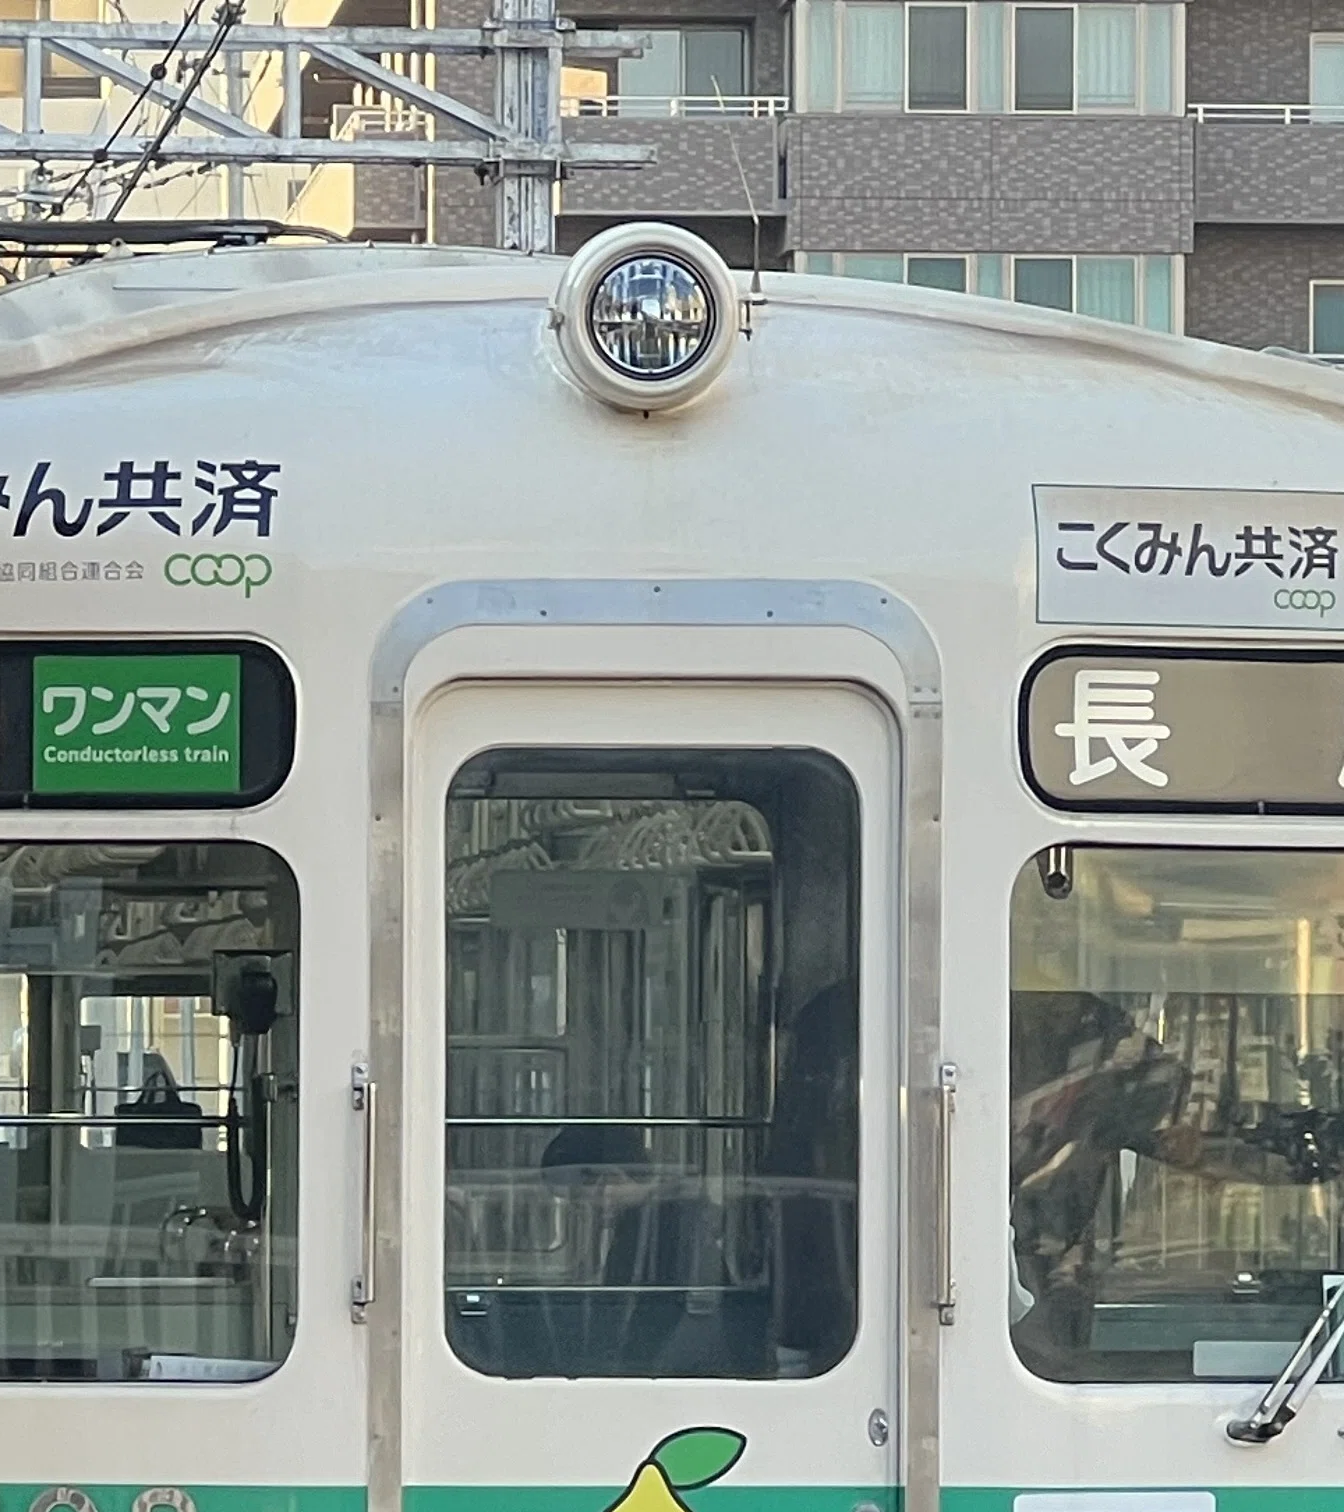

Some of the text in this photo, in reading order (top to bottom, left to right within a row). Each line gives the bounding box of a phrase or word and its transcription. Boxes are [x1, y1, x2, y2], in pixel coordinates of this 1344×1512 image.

[1056, 521, 1338, 579] こくみん共済
[164, 553, 272, 598] coop
[1273, 589, 1335, 617] coop
[43, 687, 231, 736] ワンマン
[44, 745, 229, 764] Conductorless train
